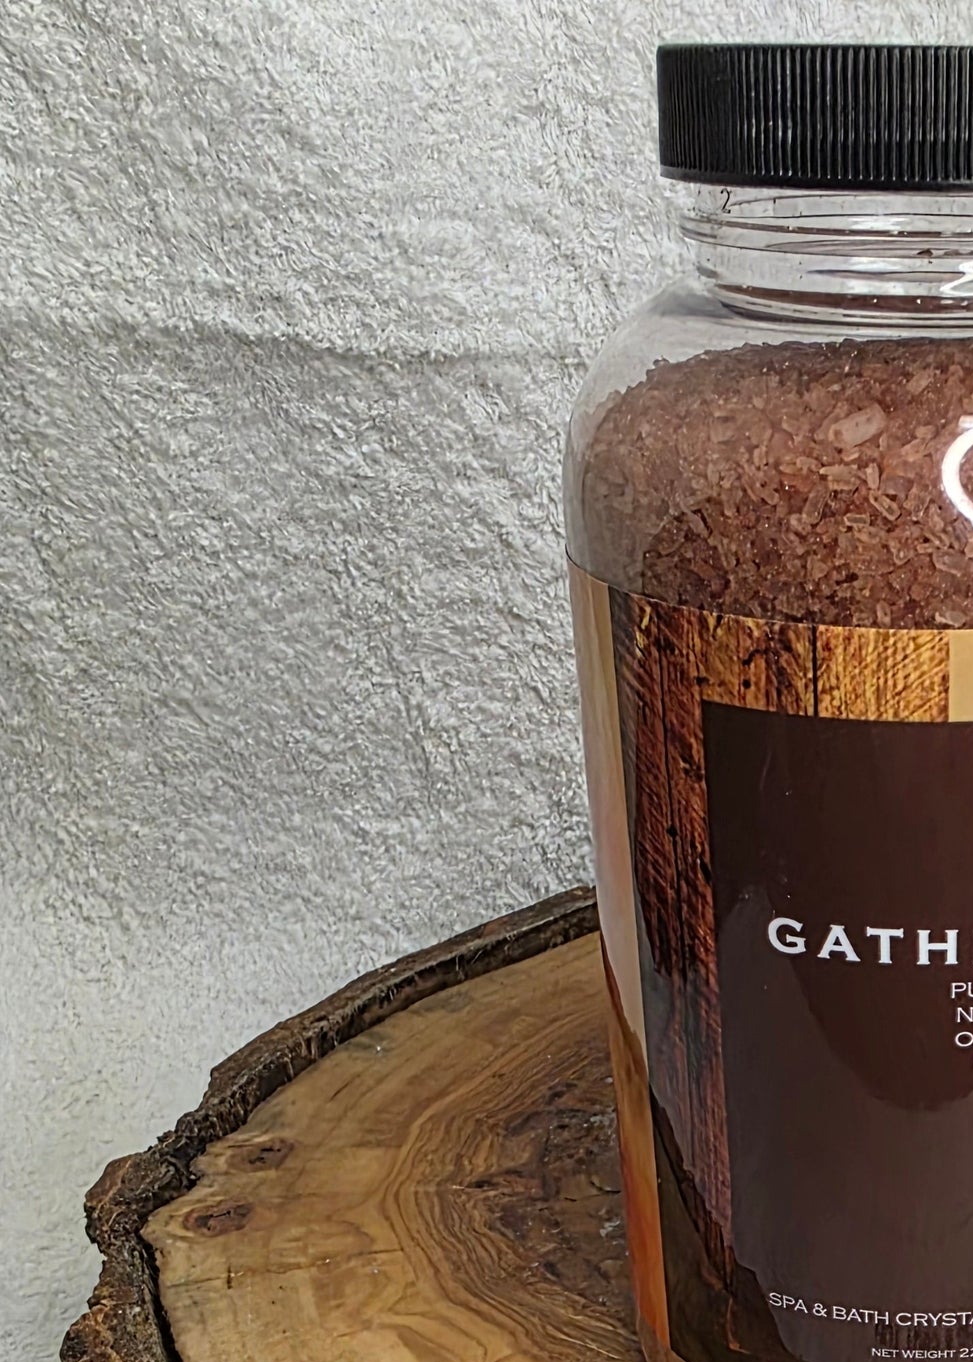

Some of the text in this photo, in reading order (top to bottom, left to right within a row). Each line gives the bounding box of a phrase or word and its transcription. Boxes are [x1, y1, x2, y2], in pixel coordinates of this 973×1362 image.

[769, 1292, 809, 1314] SPA
[812, 1302, 828, 1318] &
[832, 1305, 889, 1325] BATH
[871, 1347, 899, 1358] NET
[901, 1349, 956, 1359] WEIGHT
